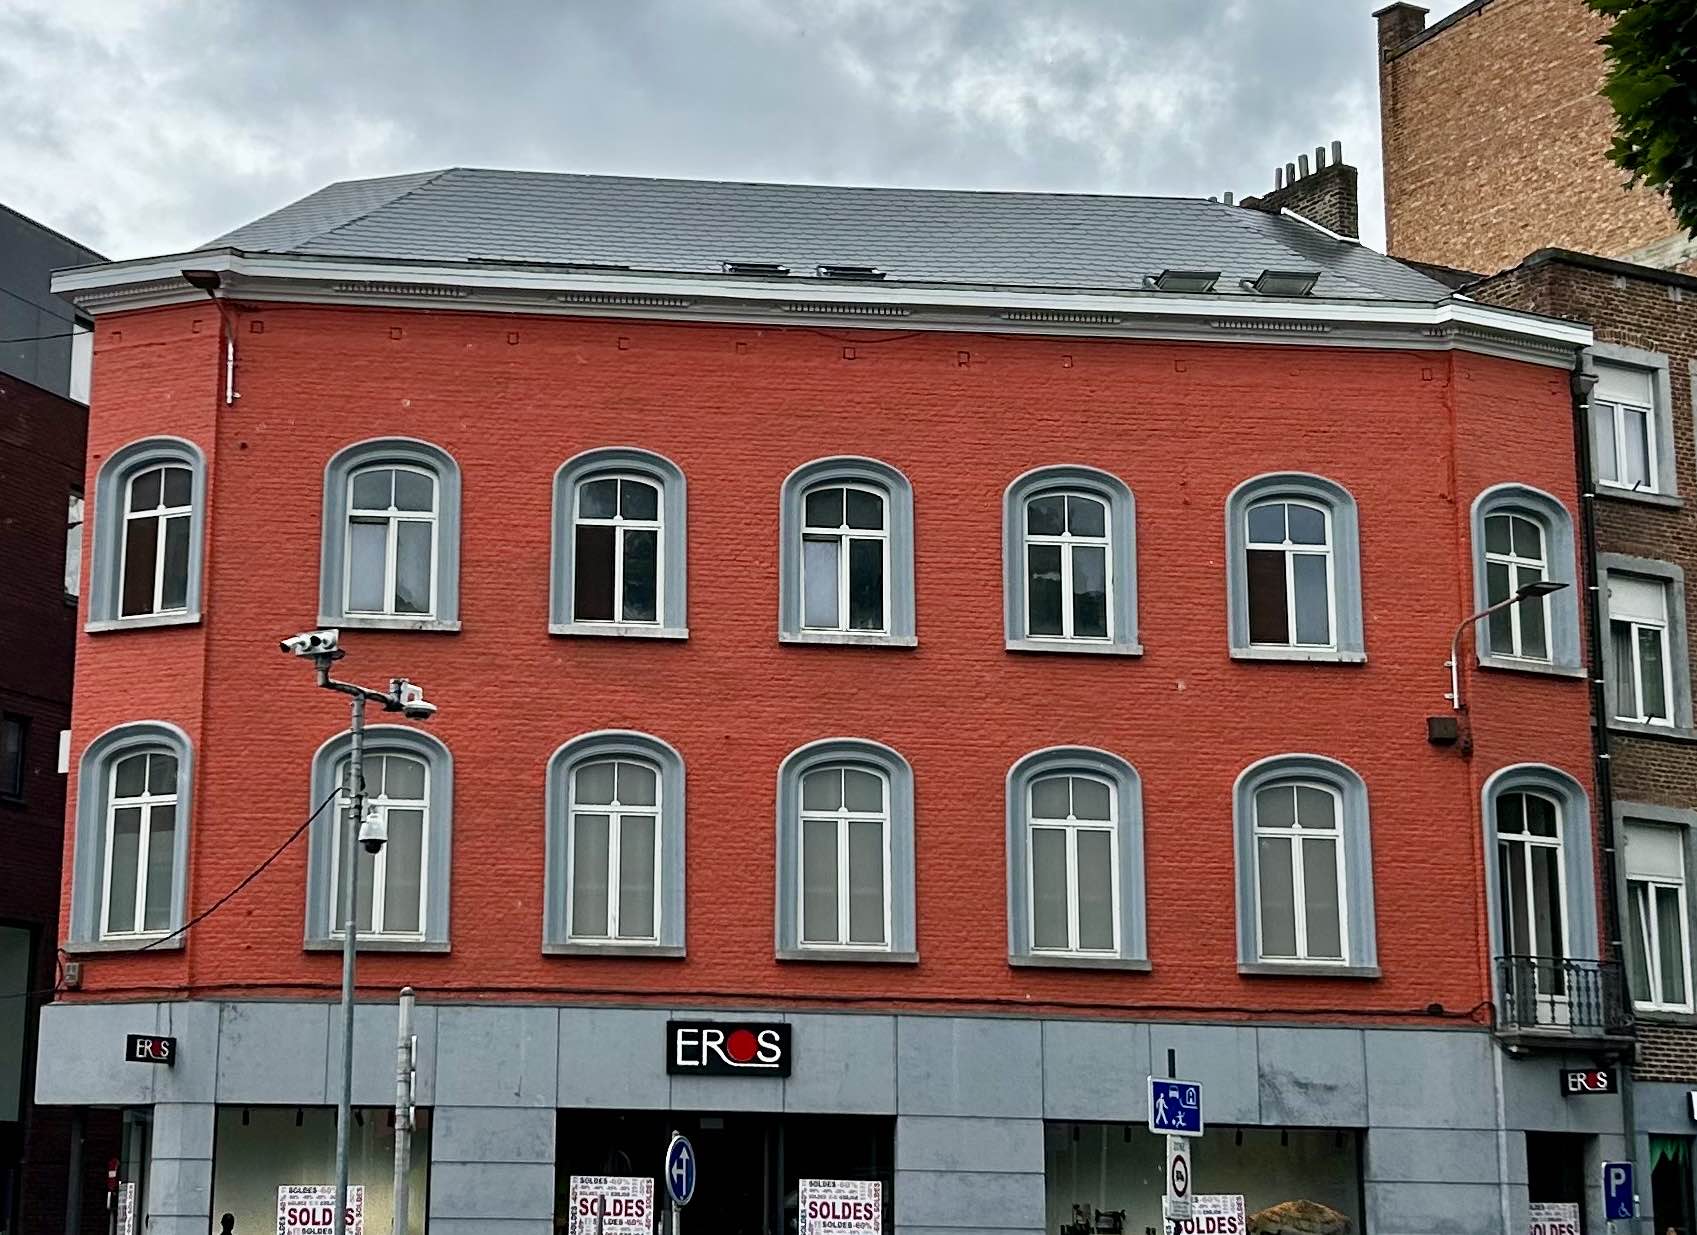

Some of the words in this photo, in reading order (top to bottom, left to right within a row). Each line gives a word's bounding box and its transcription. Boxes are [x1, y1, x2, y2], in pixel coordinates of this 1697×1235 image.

[136, 1038, 170, 1060] EROS
[677, 1028, 782, 1067] EROS
[1567, 1071, 1608, 1091] EROS
[580, 1176, 608, 1185] SOLDES
[809, 1180, 836, 1188] SOLDES
[1610, 1167, 1626, 1198] P
[287, 1207, 355, 1226] SOLDS
[808, 1201, 874, 1221] SOLDES
[302, 1227, 333, 1235] SOLDES
[822, 1221, 853, 1229] SOLDES
